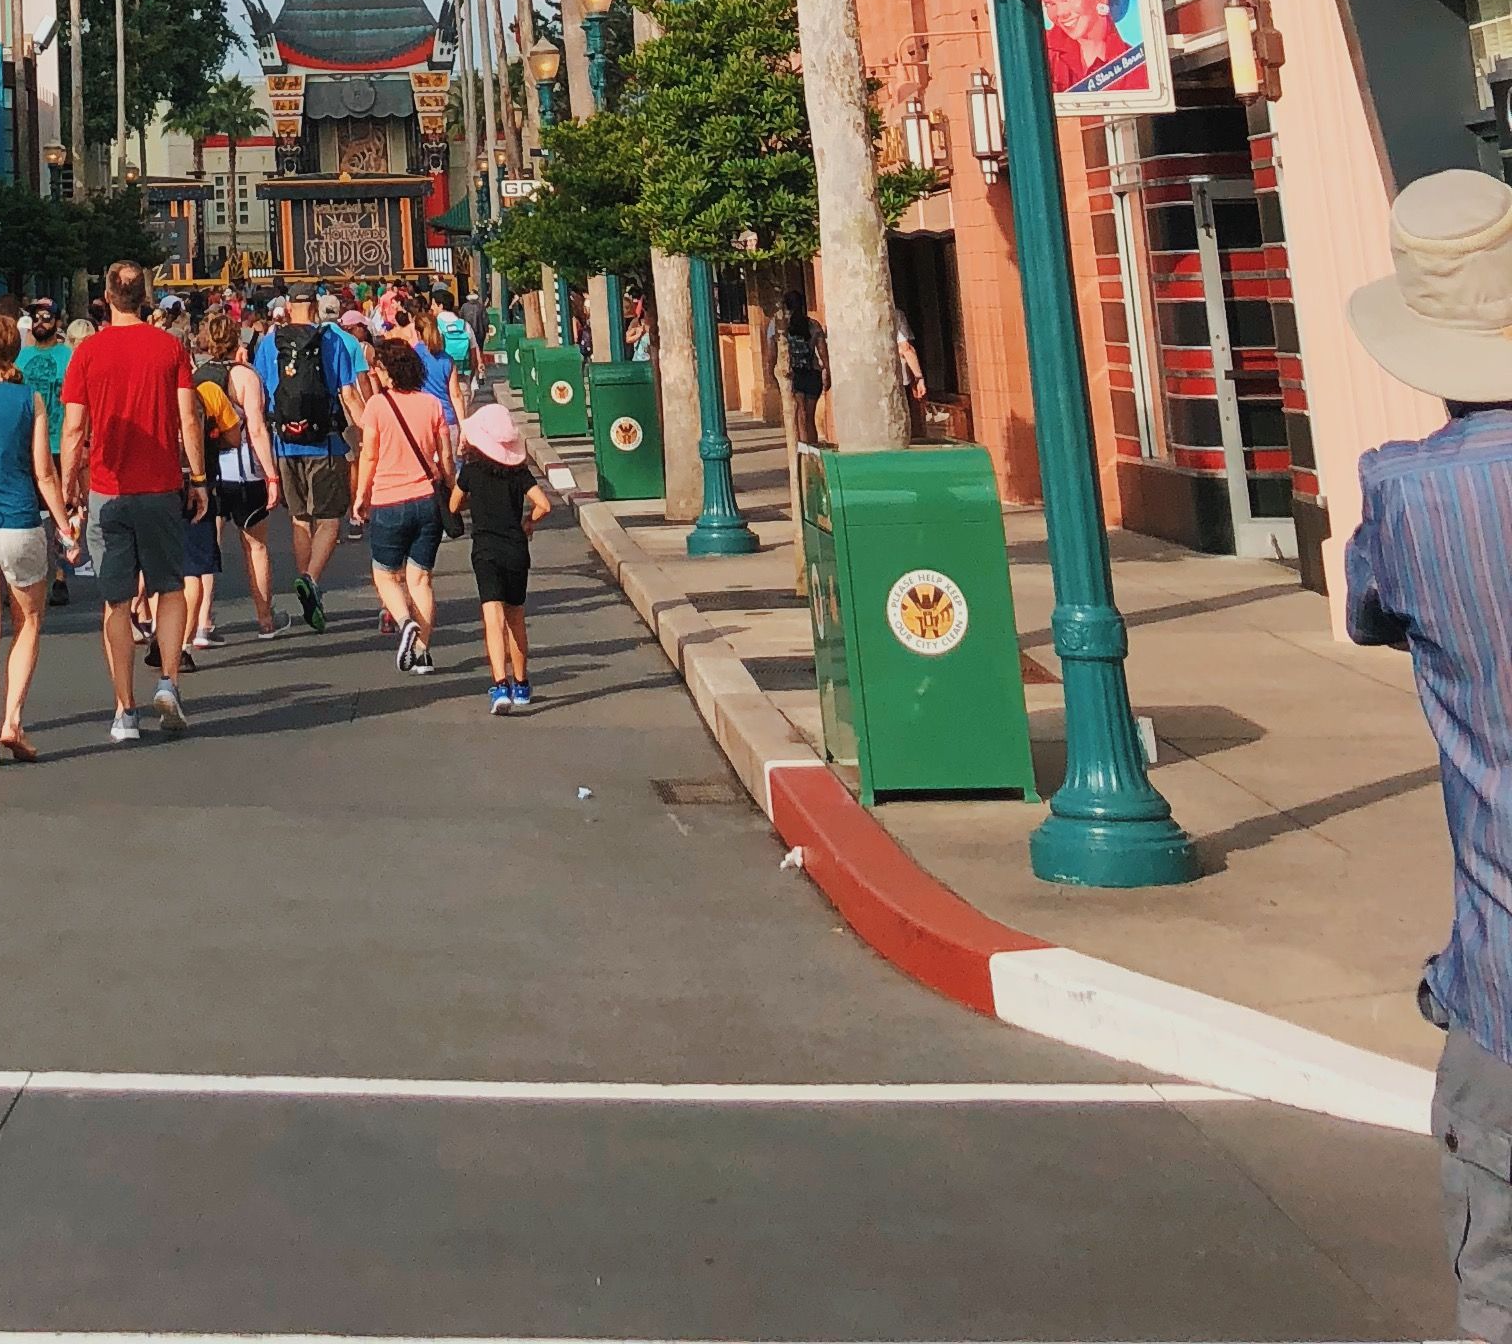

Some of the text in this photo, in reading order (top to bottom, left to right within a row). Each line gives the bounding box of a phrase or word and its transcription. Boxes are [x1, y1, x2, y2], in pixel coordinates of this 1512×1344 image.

[1088, 78, 1096, 92] A
[304, 238, 390, 267] STUDIOS
[890, 573, 963, 609] PLEASE HELP KEEP
[894, 619, 964, 649] OUR CITY CLEAN
